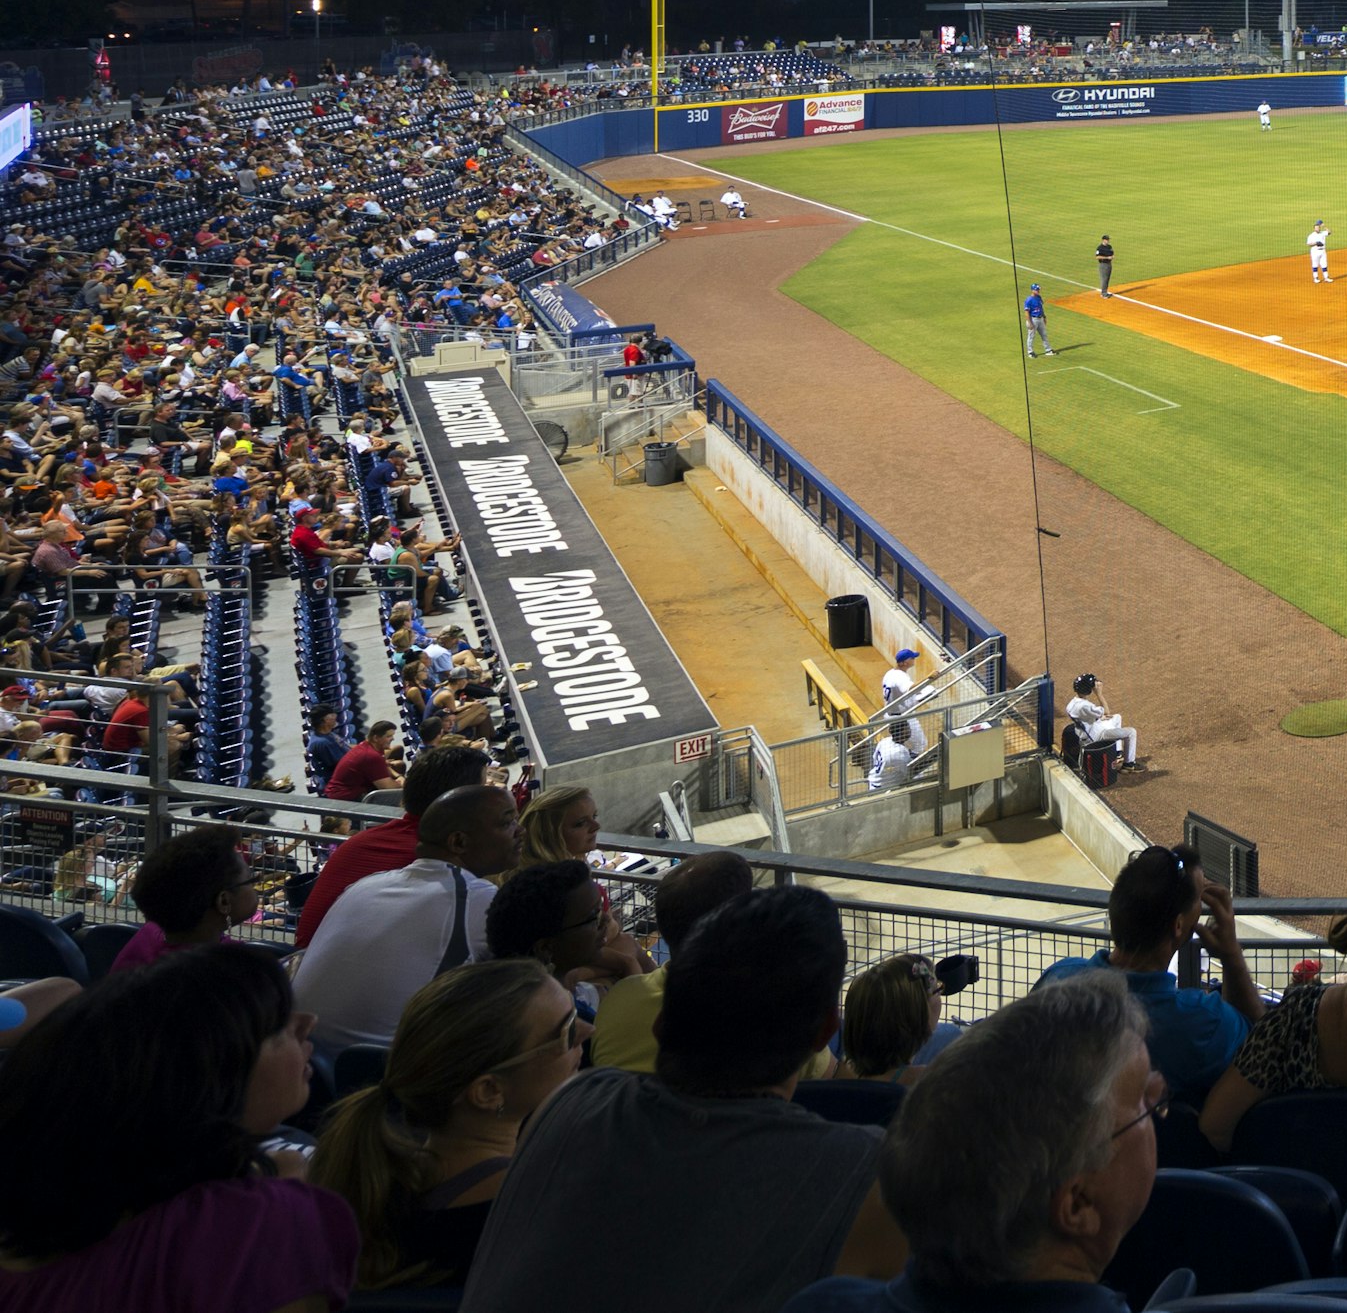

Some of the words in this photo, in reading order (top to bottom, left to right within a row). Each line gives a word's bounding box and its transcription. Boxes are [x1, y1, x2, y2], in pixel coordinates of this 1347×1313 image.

[1084, 87, 1155, 101] HYUNDAI
[818, 107, 846, 115] FINANCIAL
[819, 99, 863, 109] Advance
[687, 109, 709, 123] 330
[729, 113, 780, 125] Budweiser
[814, 124, 855, 134] af247.com
[423, 376, 510, 448] BRIDGESTONE
[458, 454, 570, 558] BRIDGESTONE
[508, 569, 662, 732] BRIDGESTONE
[680, 737, 707, 755] EXIT
[22, 808, 68, 822] ATTENTION
